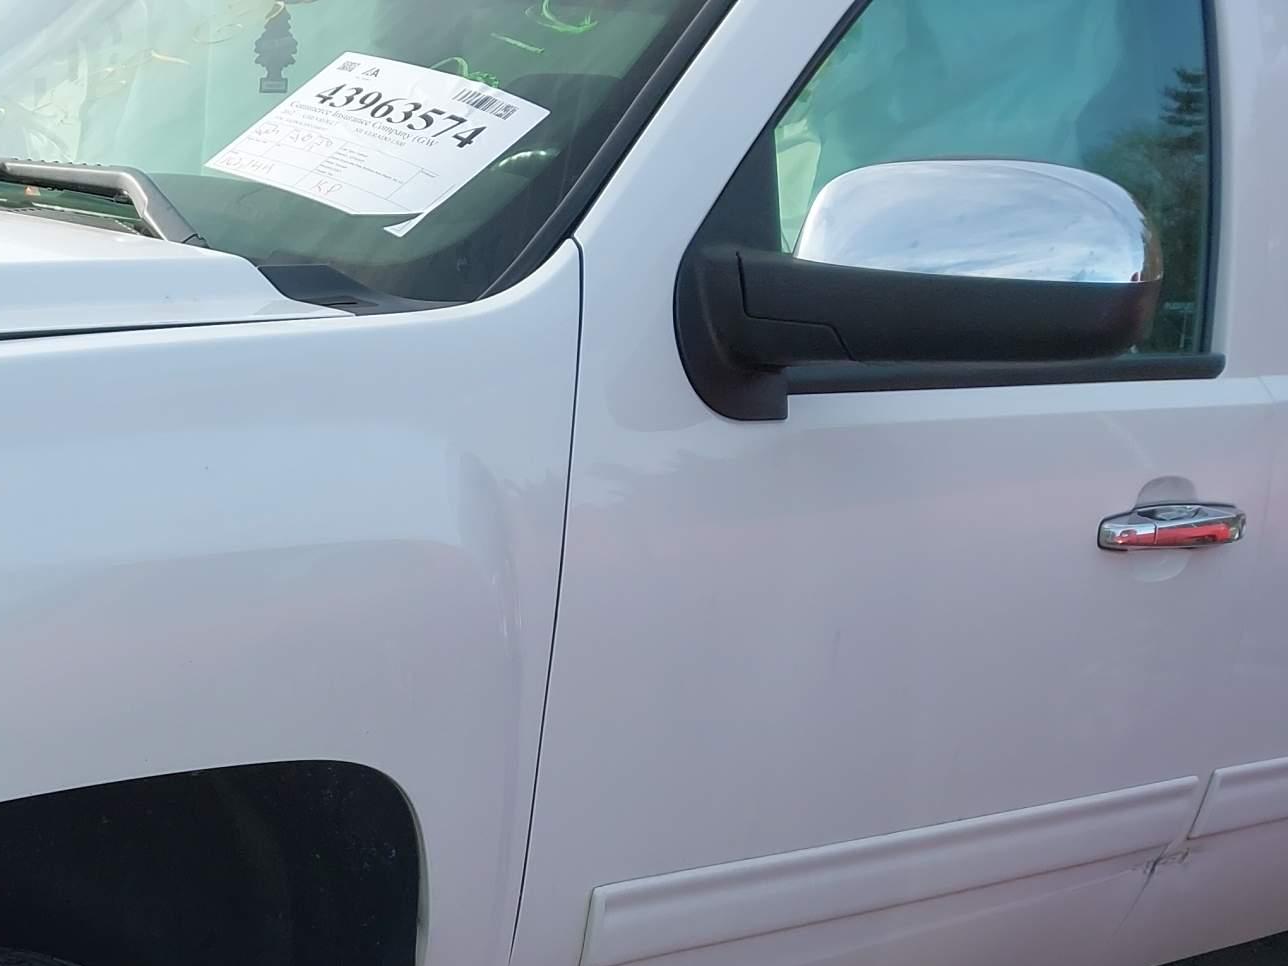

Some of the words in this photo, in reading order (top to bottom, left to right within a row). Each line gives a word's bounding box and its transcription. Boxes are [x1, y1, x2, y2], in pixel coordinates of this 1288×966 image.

[315, 83, 487, 148] 43963574
[332, 110, 372, 126] Insurance
[372, 120, 411, 140] Company
